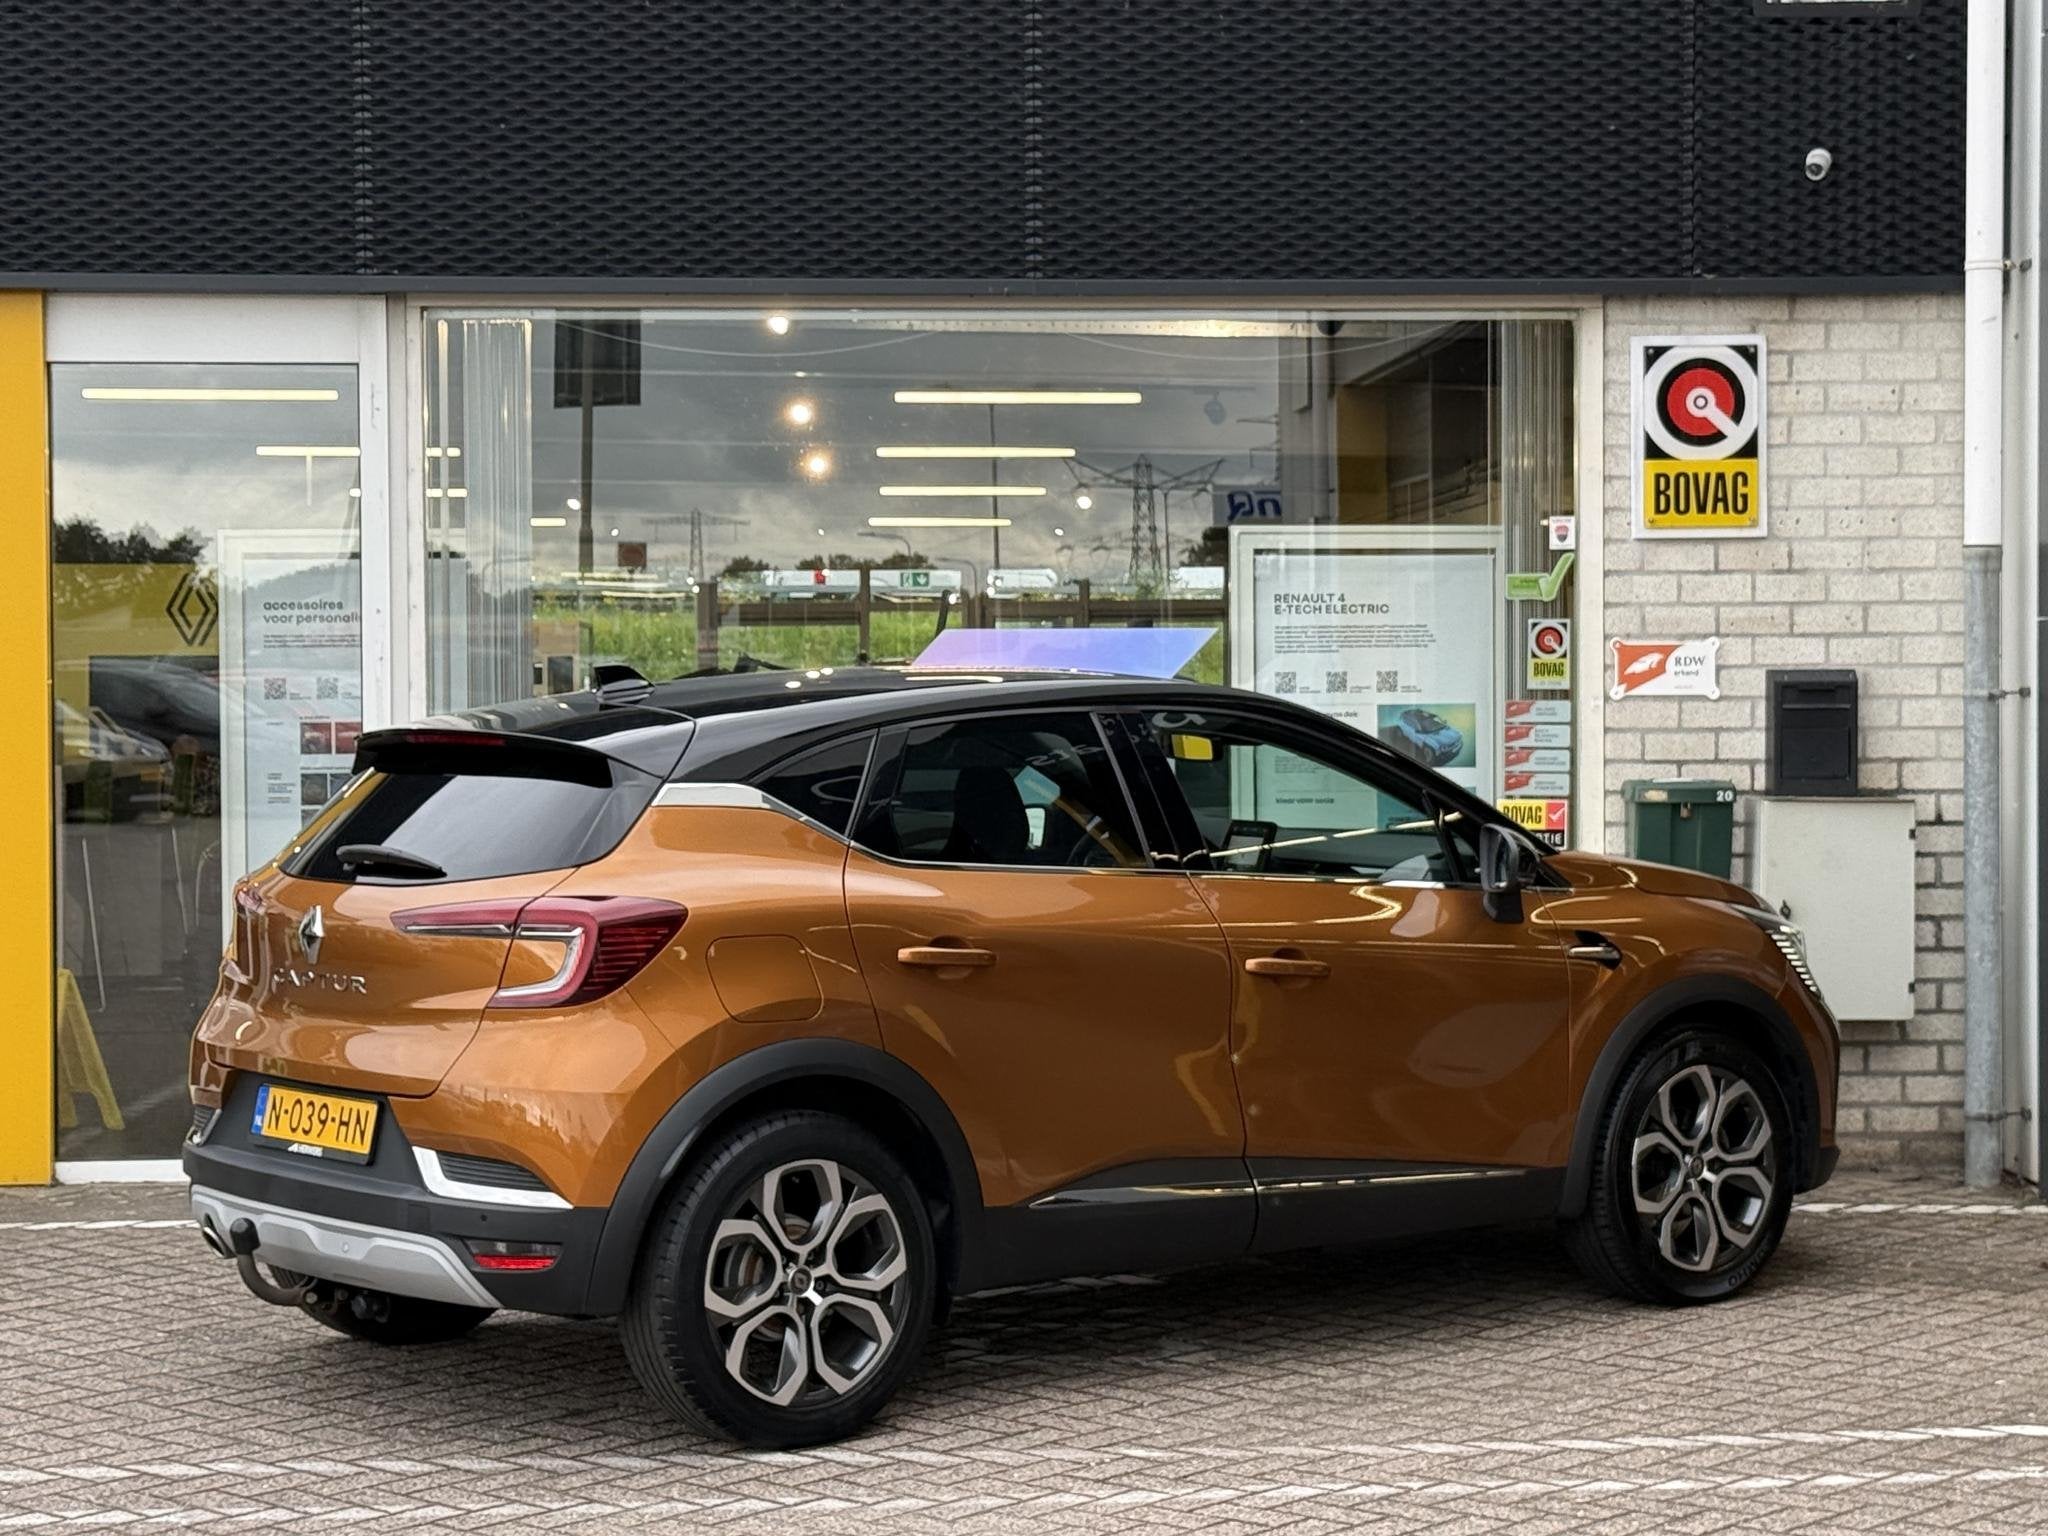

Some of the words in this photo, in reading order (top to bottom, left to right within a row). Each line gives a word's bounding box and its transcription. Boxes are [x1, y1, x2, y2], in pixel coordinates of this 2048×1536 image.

[1653, 471, 1749, 515] BOVAG
[1273, 593, 1335, 603] RENAULT
[1337, 593, 1346, 603] 4
[1274, 604, 1322, 615] E-TECH
[1325, 604, 1390, 614] ELECTRIC
[263, 614, 293, 624] voor
[296, 611, 361, 626] personali
[1674, 656, 1706, 666] RDW
[1533, 662, 1565, 677] BOVAG
[1716, 790, 1734, 802] 20
[271, 967, 367, 994] CAPTUR
[267, 1095, 370, 1147] N-039-HN
